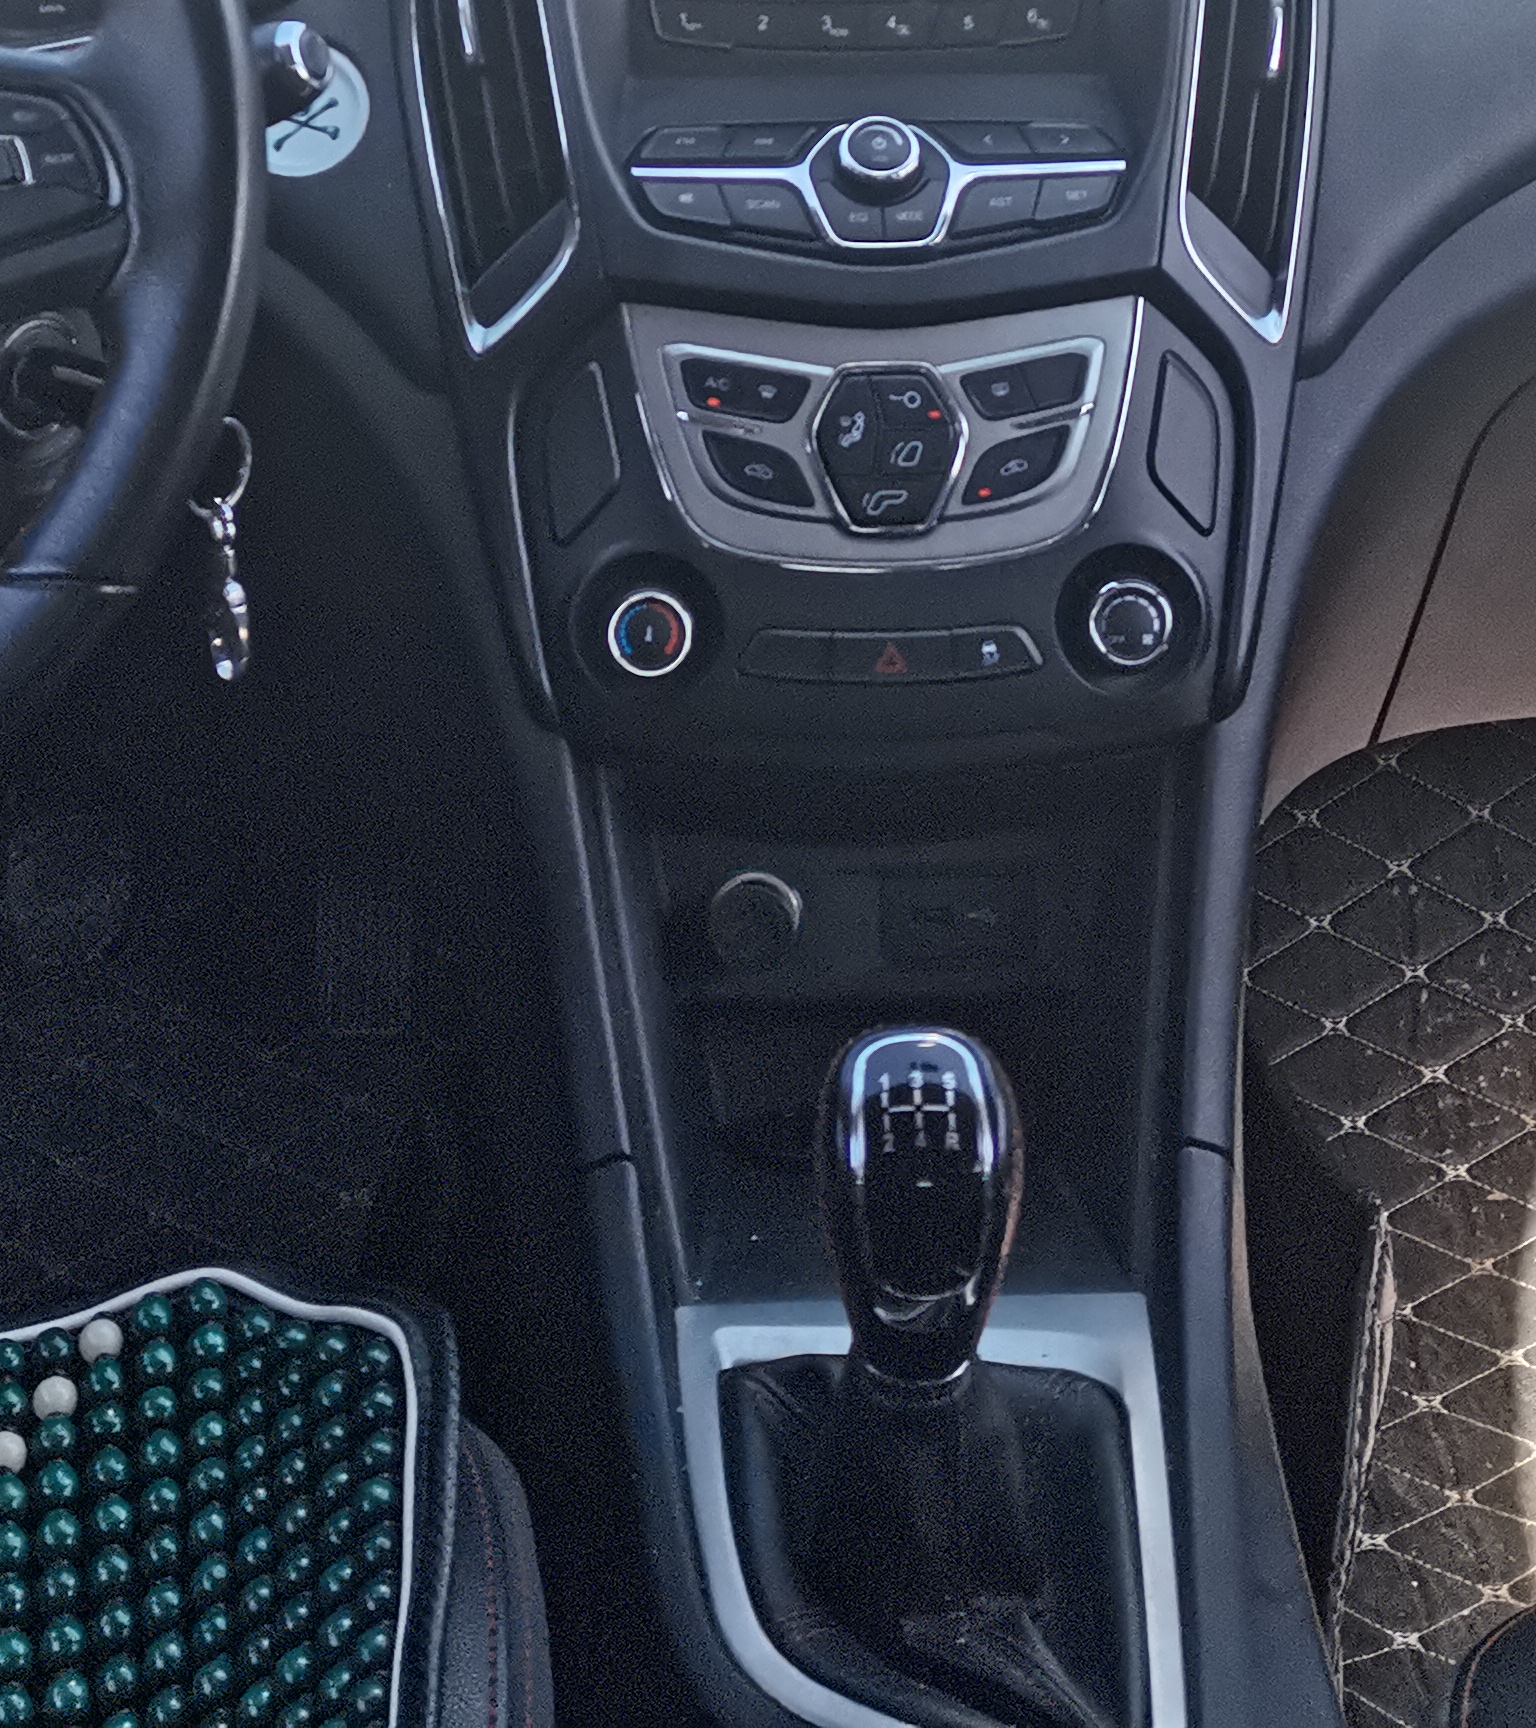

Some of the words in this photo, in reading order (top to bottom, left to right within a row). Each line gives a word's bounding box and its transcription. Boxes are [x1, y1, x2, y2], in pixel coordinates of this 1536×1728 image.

[758, 15, 769, 31] 2
[821, 15, 832, 31] 3
[878, 1072, 889, 1090] 1
[908, 1070, 923, 1088] 3
[942, 1071, 956, 1089] 5
[882, 1132, 896, 1152] 2
[945, 1131, 961, 1150] R
